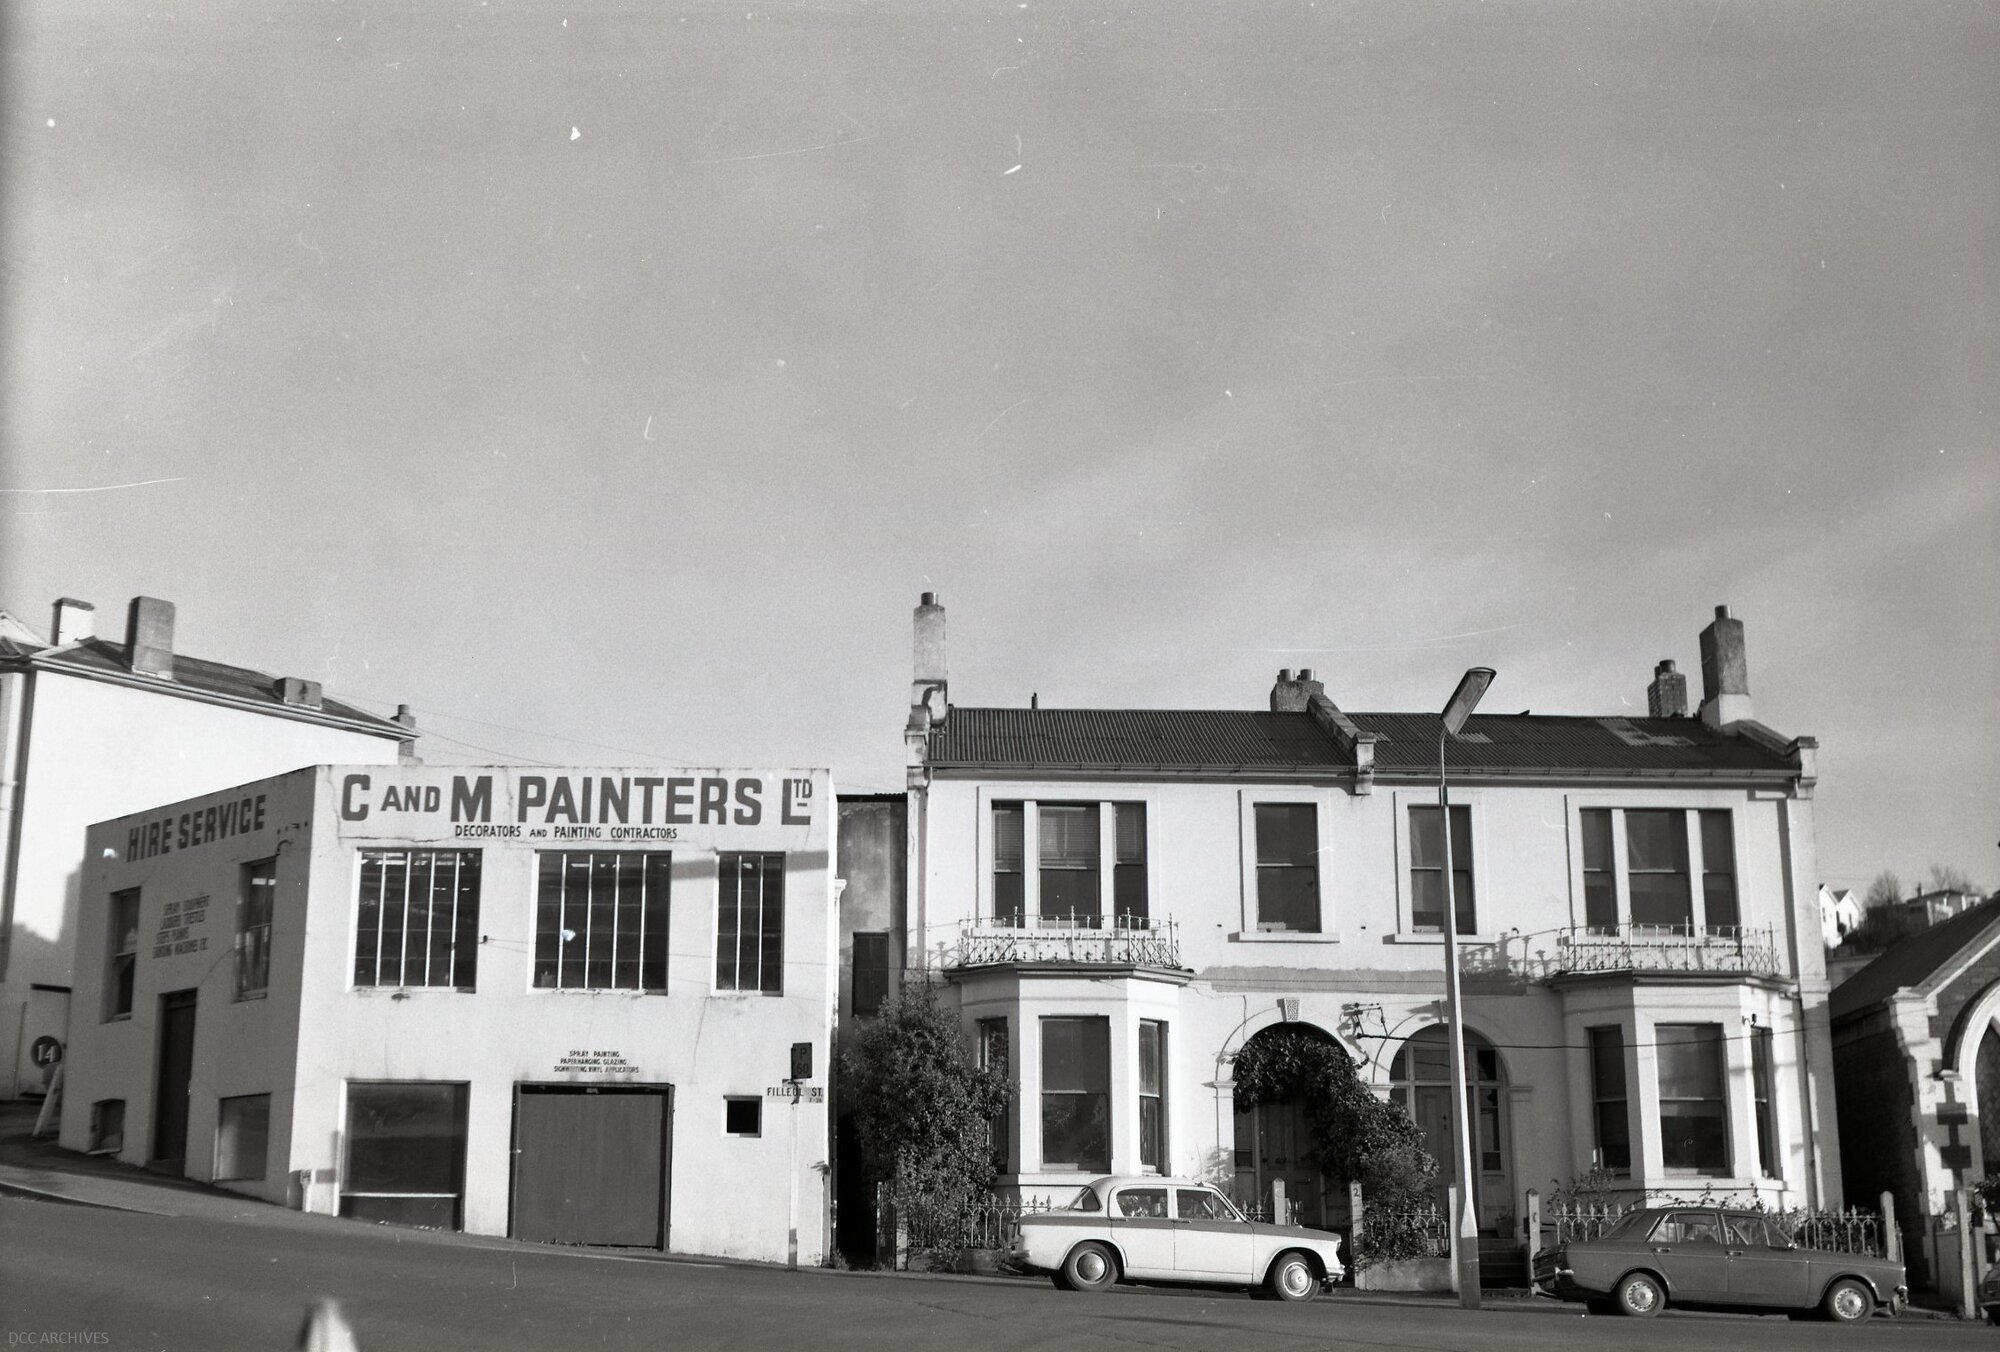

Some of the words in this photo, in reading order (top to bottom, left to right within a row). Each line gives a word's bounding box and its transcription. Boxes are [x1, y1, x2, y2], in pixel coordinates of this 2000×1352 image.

[341, 773, 371, 822] C
[380, 785, 441, 813] AND
[450, 775, 493, 823] M
[517, 775, 763, 826] PAINTERS
[126, 818, 173, 863] HIRE
[177, 794, 267, 850] SERVICE
[455, 824, 522, 838] DECORATORS
[529, 828, 547, 838] AND
[554, 826, 601, 839] PAINTING
[610, 826, 678, 839] CONTRACTORS
[37, 1043, 57, 1063] 14
[593, 1050, 620, 1058] PAINTING
[1352, 1187, 1360, 1197] 2
